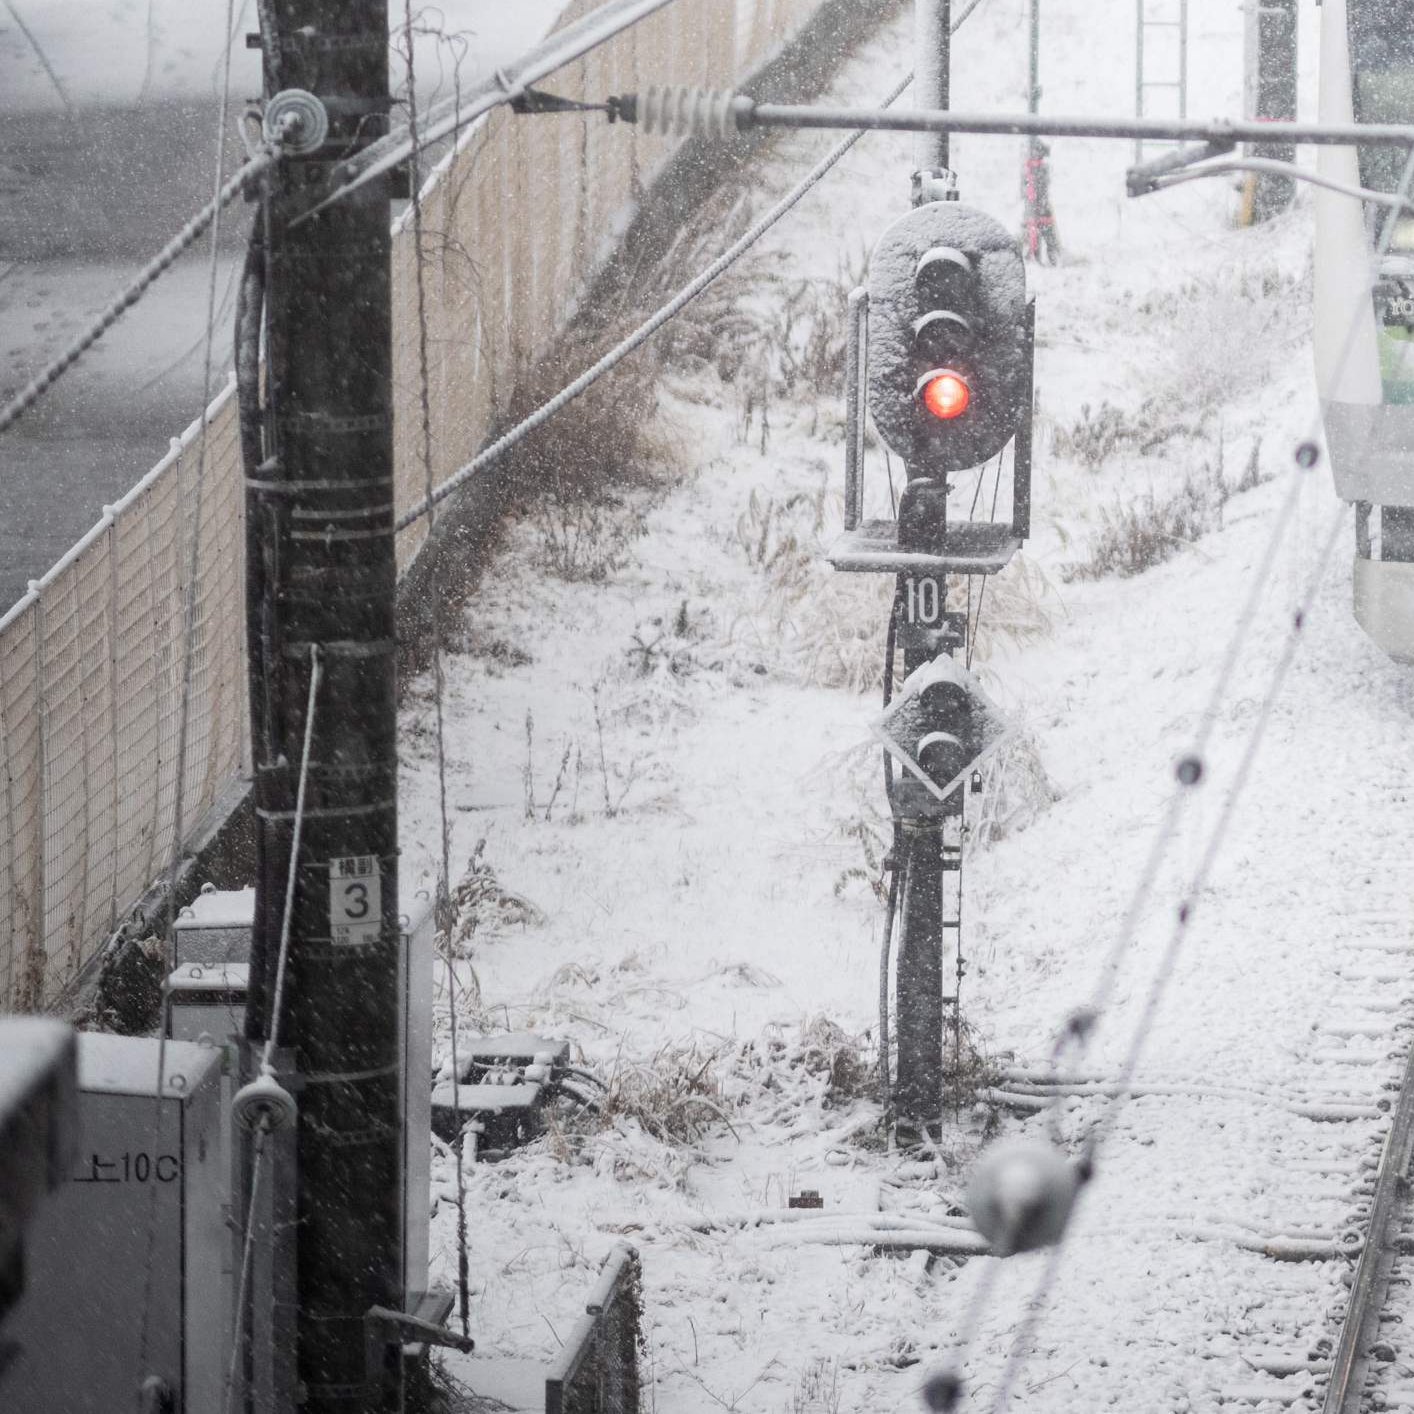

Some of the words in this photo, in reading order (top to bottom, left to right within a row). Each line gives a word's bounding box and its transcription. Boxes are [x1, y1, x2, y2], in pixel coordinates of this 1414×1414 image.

[905, 577, 939, 623] 10
[344, 882, 369, 919] 3
[73, 1152, 178, 1183] 上10C
